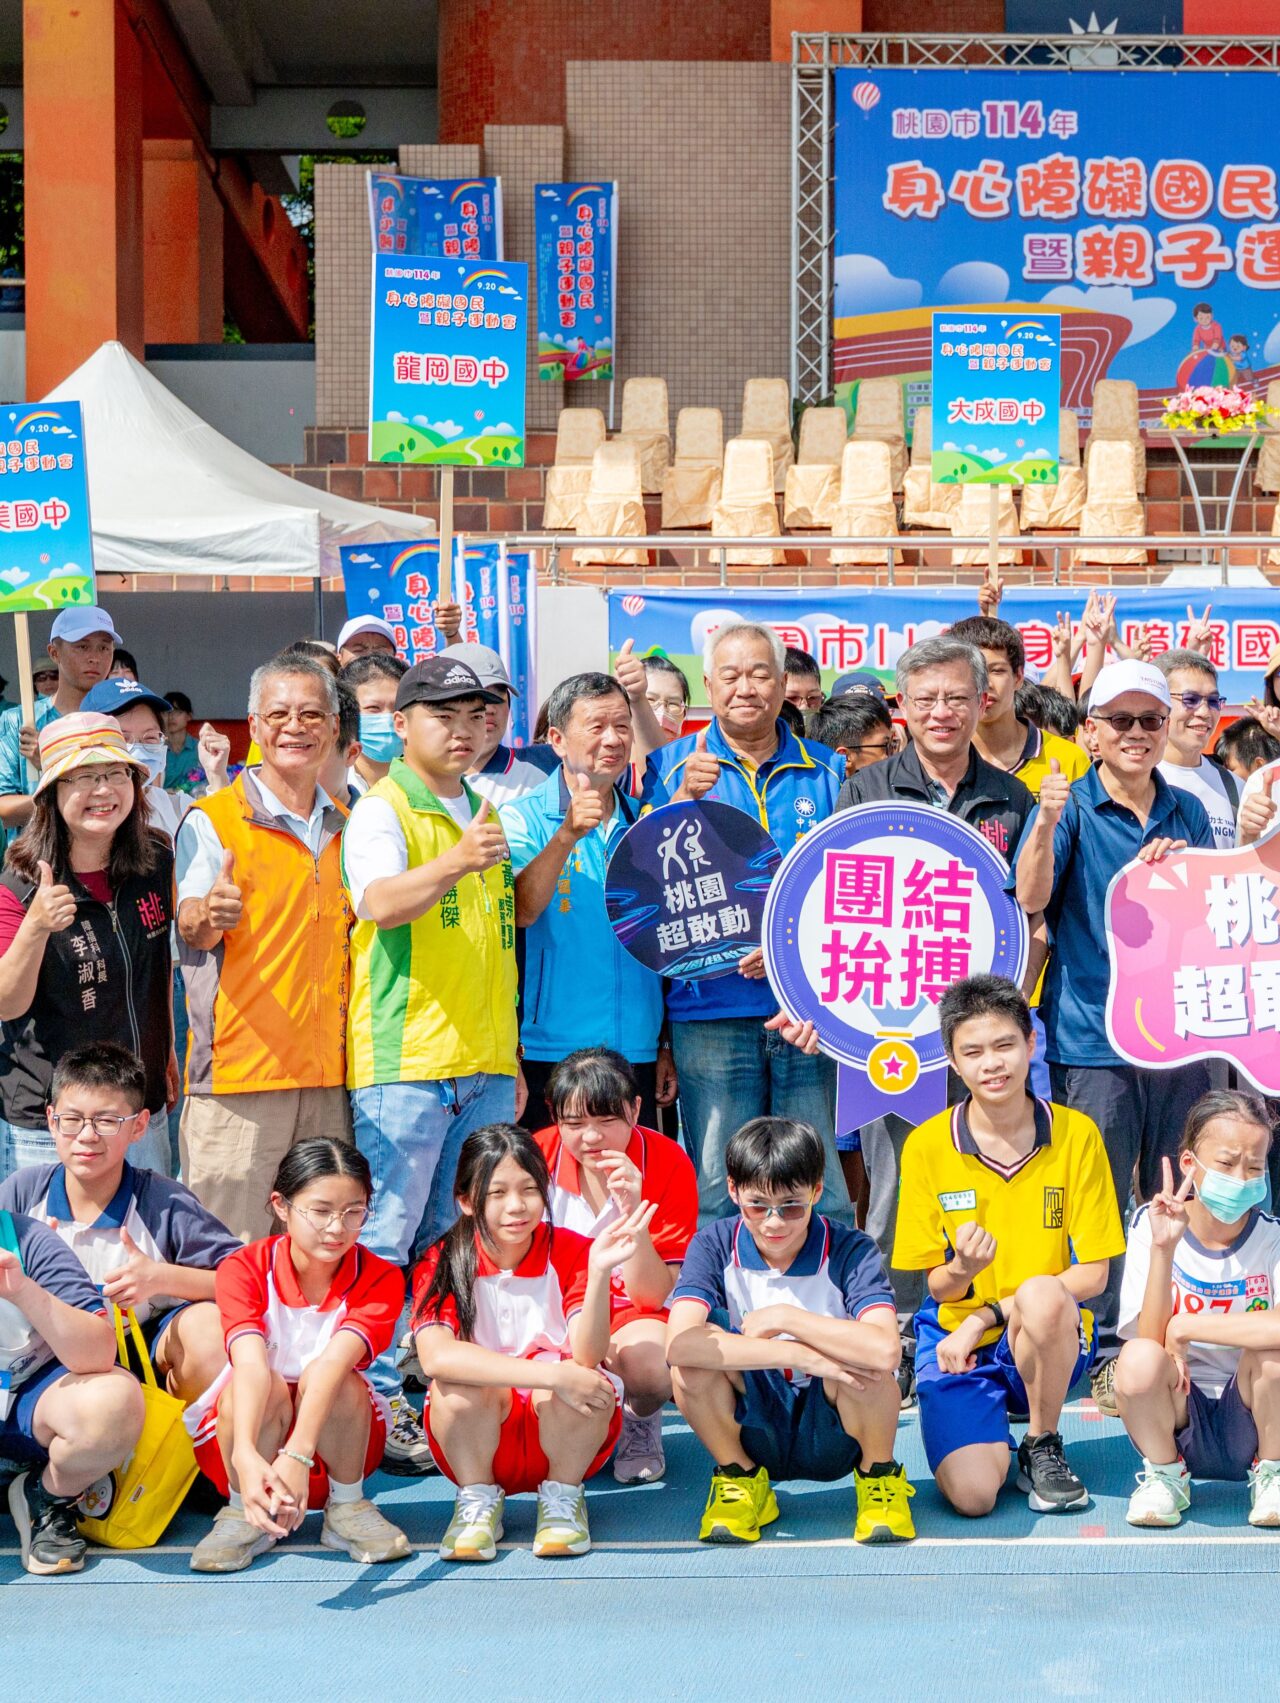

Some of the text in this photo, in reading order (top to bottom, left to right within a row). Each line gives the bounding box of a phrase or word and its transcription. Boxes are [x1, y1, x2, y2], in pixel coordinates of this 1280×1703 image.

[893, 102, 1077, 138] 桃園市114年
[885, 155, 1279, 221] 身心障礙國民
[385, 290, 485, 311] 身心障礙國民
[477, 281, 497, 291] 9.20
[419, 311, 517, 330] 暨親子運動會
[396, 354, 507, 387] 龍岡國中
[949, 399, 1044, 424] 大成國中
[30, 425, 49, 433] 9.20
[444, 675, 476, 686] adidas
[662, 872, 727, 914] 桃園
[823, 851, 976, 935] 團結
[656, 904, 752, 954] 超敢動
[70, 935, 97, 1012] 李淑香
[820, 929, 974, 1009] 拚搏
